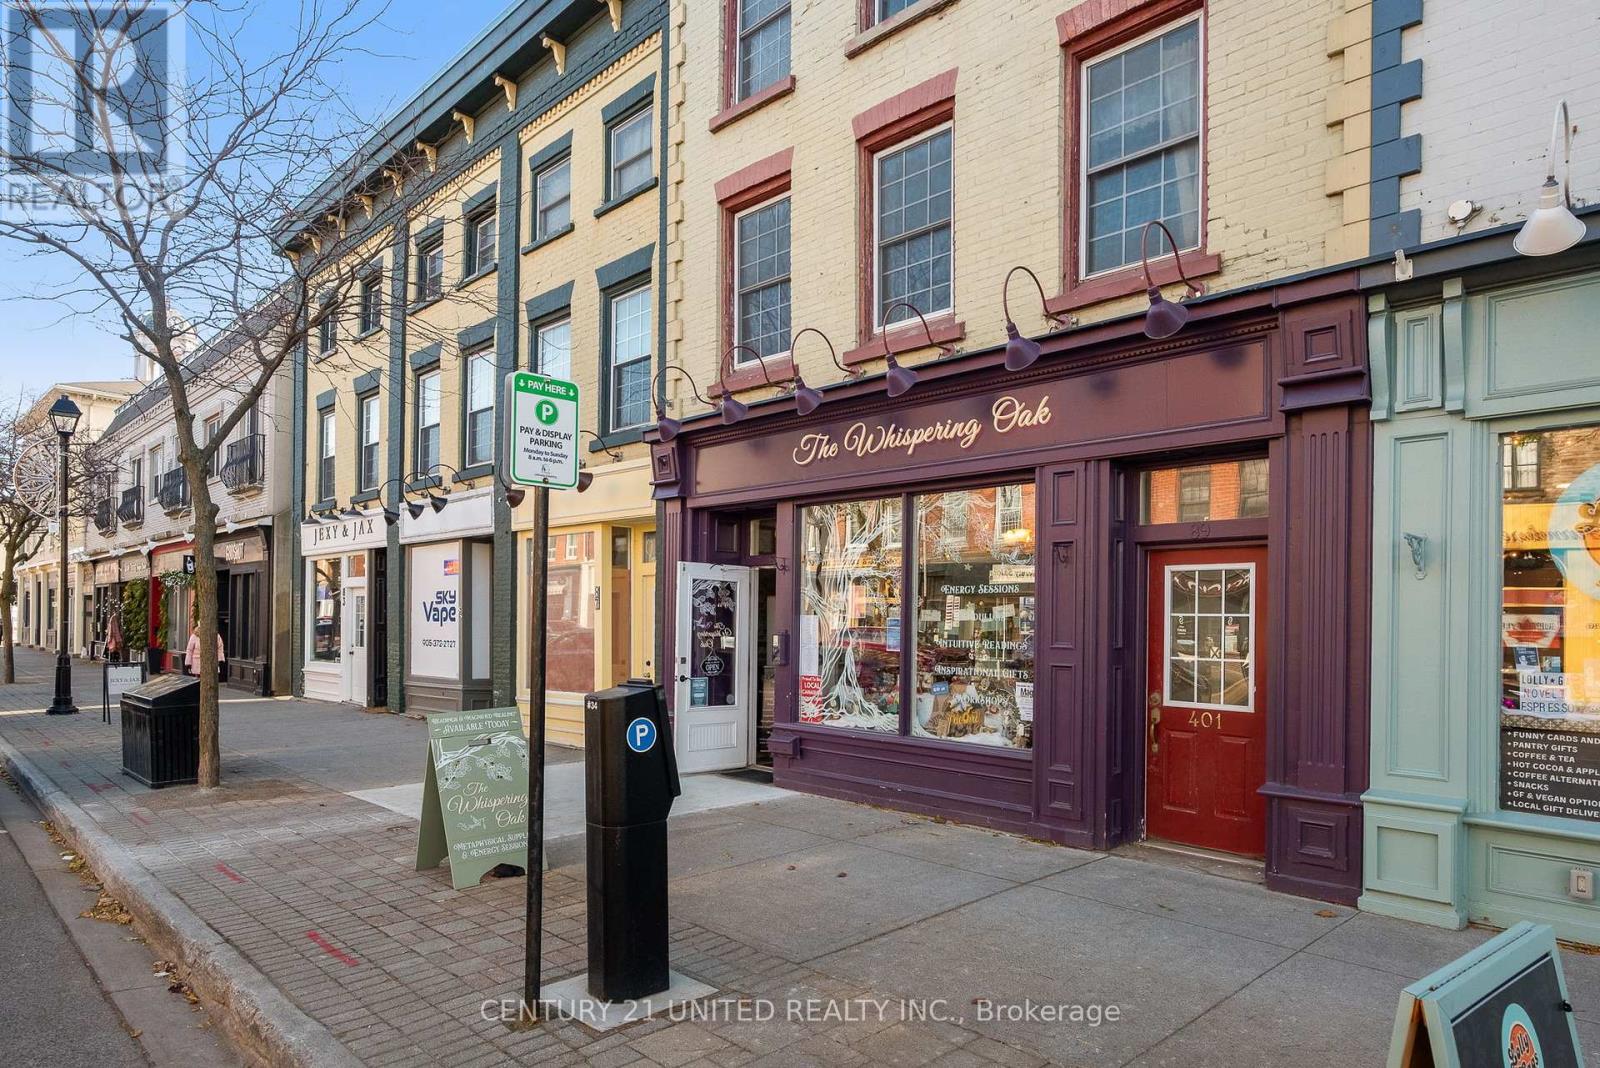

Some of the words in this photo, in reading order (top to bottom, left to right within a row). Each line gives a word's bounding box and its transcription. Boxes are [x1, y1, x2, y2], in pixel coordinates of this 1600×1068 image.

[527, 380, 544, 391] PAY
[545, 384, 567, 395] HERE
[541, 404, 553, 421] P
[519, 425, 535, 435] PAY
[535, 428, 542, 436] &
[542, 430, 573, 441] DISPLAY
[793, 433, 839, 465] The
[844, 418, 981, 457] Whispering
[991, 395, 1052, 433] Oak
[529, 438, 563, 449] PARKING
[523, 447, 544, 456] Monday
[550, 451, 569, 460] Sunday
[313, 525, 338, 546] JEXY
[342, 527, 349, 538] &
[352, 519, 374, 541] JAX
[940, 584, 976, 595] ENERGY
[978, 583, 1020, 594] SESSIONS
[435, 590, 456, 605] SKY
[422, 601, 456, 627] Vape
[934, 639, 980, 649] INTUITIVE
[981, 639, 1028, 651] READINGS
[1001, 668, 1029, 680] GIFTS
[586, 700, 598, 710] #34
[443, 722, 484, 735] AVAILABLE
[485, 719, 510, 729] TODAY
[1188, 711, 1222, 730] 401
[635, 724, 649, 746] P
[1547, 733, 1579, 743] CARDS
[1580, 736, 1600, 745] AND
[1512, 741, 1549, 751] PANTRY
[1551, 744, 1578, 753] GIFTS
[1512, 751, 1547, 761] COFFEE
[1549, 753, 1556, 761] &
[1558, 755, 1575, 763] TEA
[1512, 761, 1531, 769] HOT
[1533, 763, 1564, 773] COCOA
[1566, 766, 1574, 774] &
[1513, 771, 1548, 781] COFFEE
[463, 782, 488, 796] The
[1513, 780, 1549, 791] SNACKS
[1512, 790, 1525, 798] GF
[1526, 792, 1534, 800] &
[1535, 793, 1567, 804] VEGAN
[447, 793, 528, 815] Whispering
[1512, 800, 1541, 811] LOCAL
[1543, 804, 1564, 813] GIFT
[495, 809, 527, 828] Oak
[470, 846, 500, 857] ENERGY
